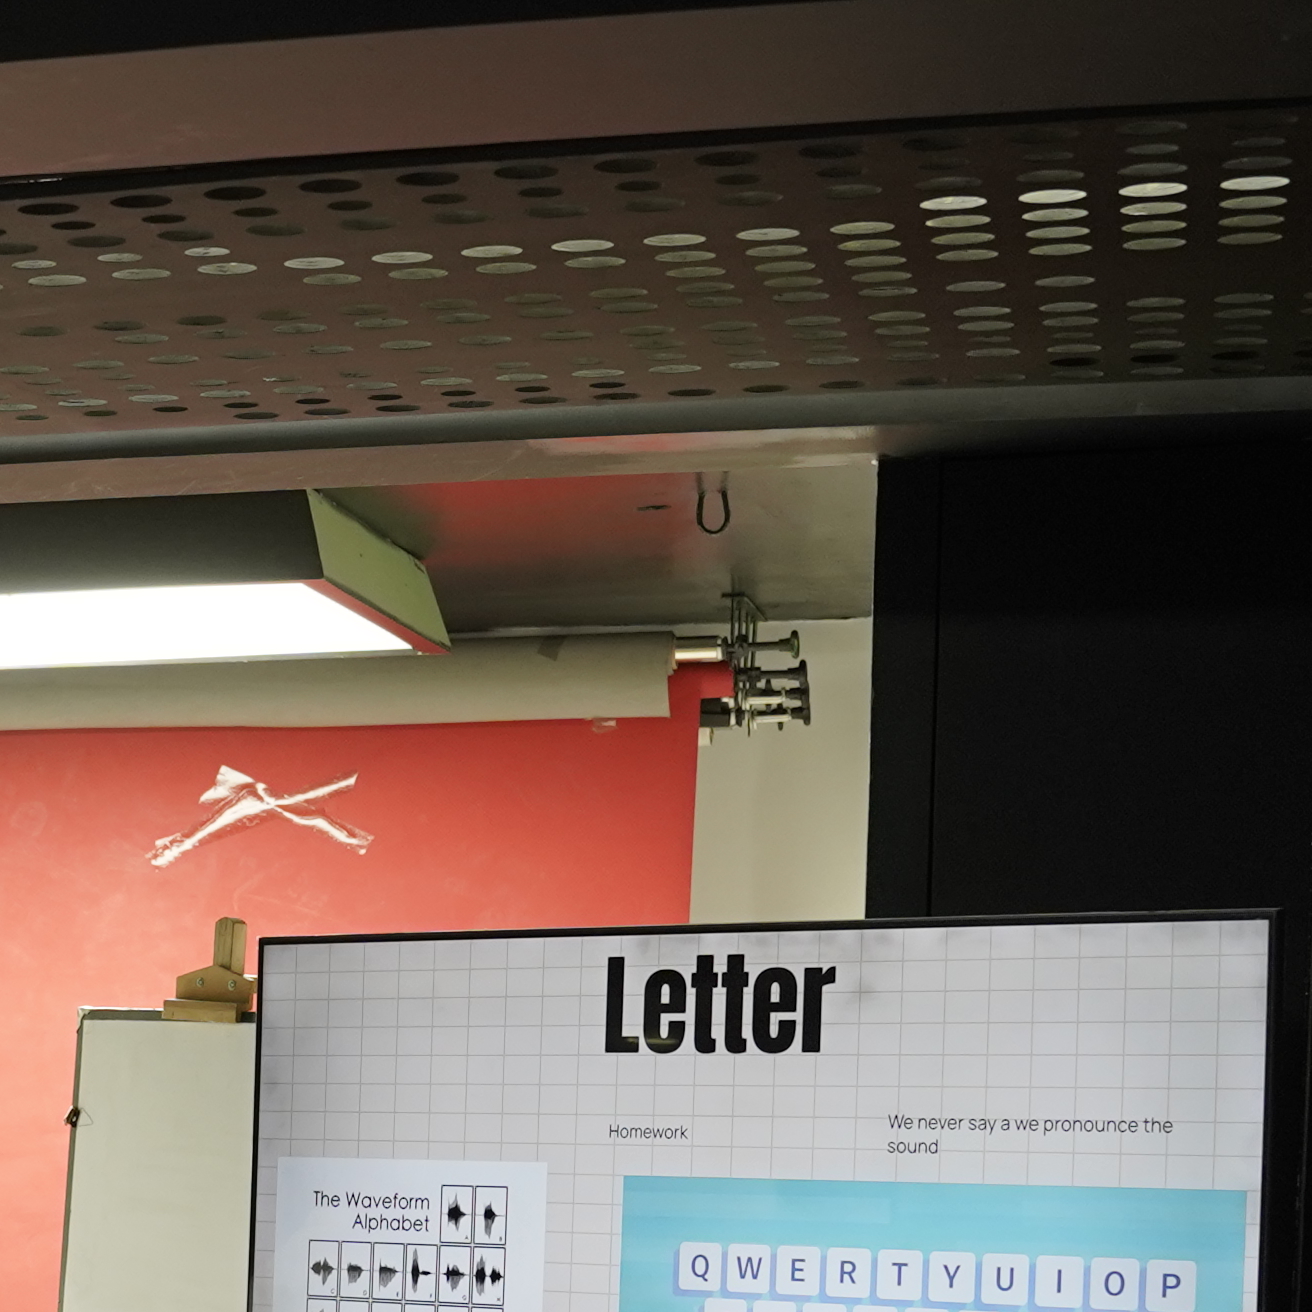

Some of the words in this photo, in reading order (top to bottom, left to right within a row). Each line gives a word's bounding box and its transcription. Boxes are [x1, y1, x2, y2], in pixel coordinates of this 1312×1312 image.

[605, 954, 836, 1053] Letter
[609, 1124, 688, 1140] Homework
[888, 1114, 913, 1129] We
[918, 1115, 963, 1130] never
[968, 1118, 997, 1135] say
[1000, 1119, 1010, 1131] a
[1015, 1119, 1039, 1131] we
[1044, 1118, 1138, 1136] pronounce
[1144, 1117, 1173, 1133] the
[887, 1139, 939, 1154] sound
[313, 1190, 341, 1208] The
[345, 1191, 430, 1210] Waveform
[352, 1213, 429, 1233] Alphabet
[691, 1254, 710, 1283] Q
[736, 1256, 763, 1280] W
[790, 1258, 806, 1282] E
[839, 1260, 857, 1285] R
[891, 1262, 909, 1287] T
[943, 1264, 961, 1289] Y
[996, 1266, 1015, 1292] U
[1104, 1270, 1126, 1297] O
[1161, 1272, 1182, 1299] P
